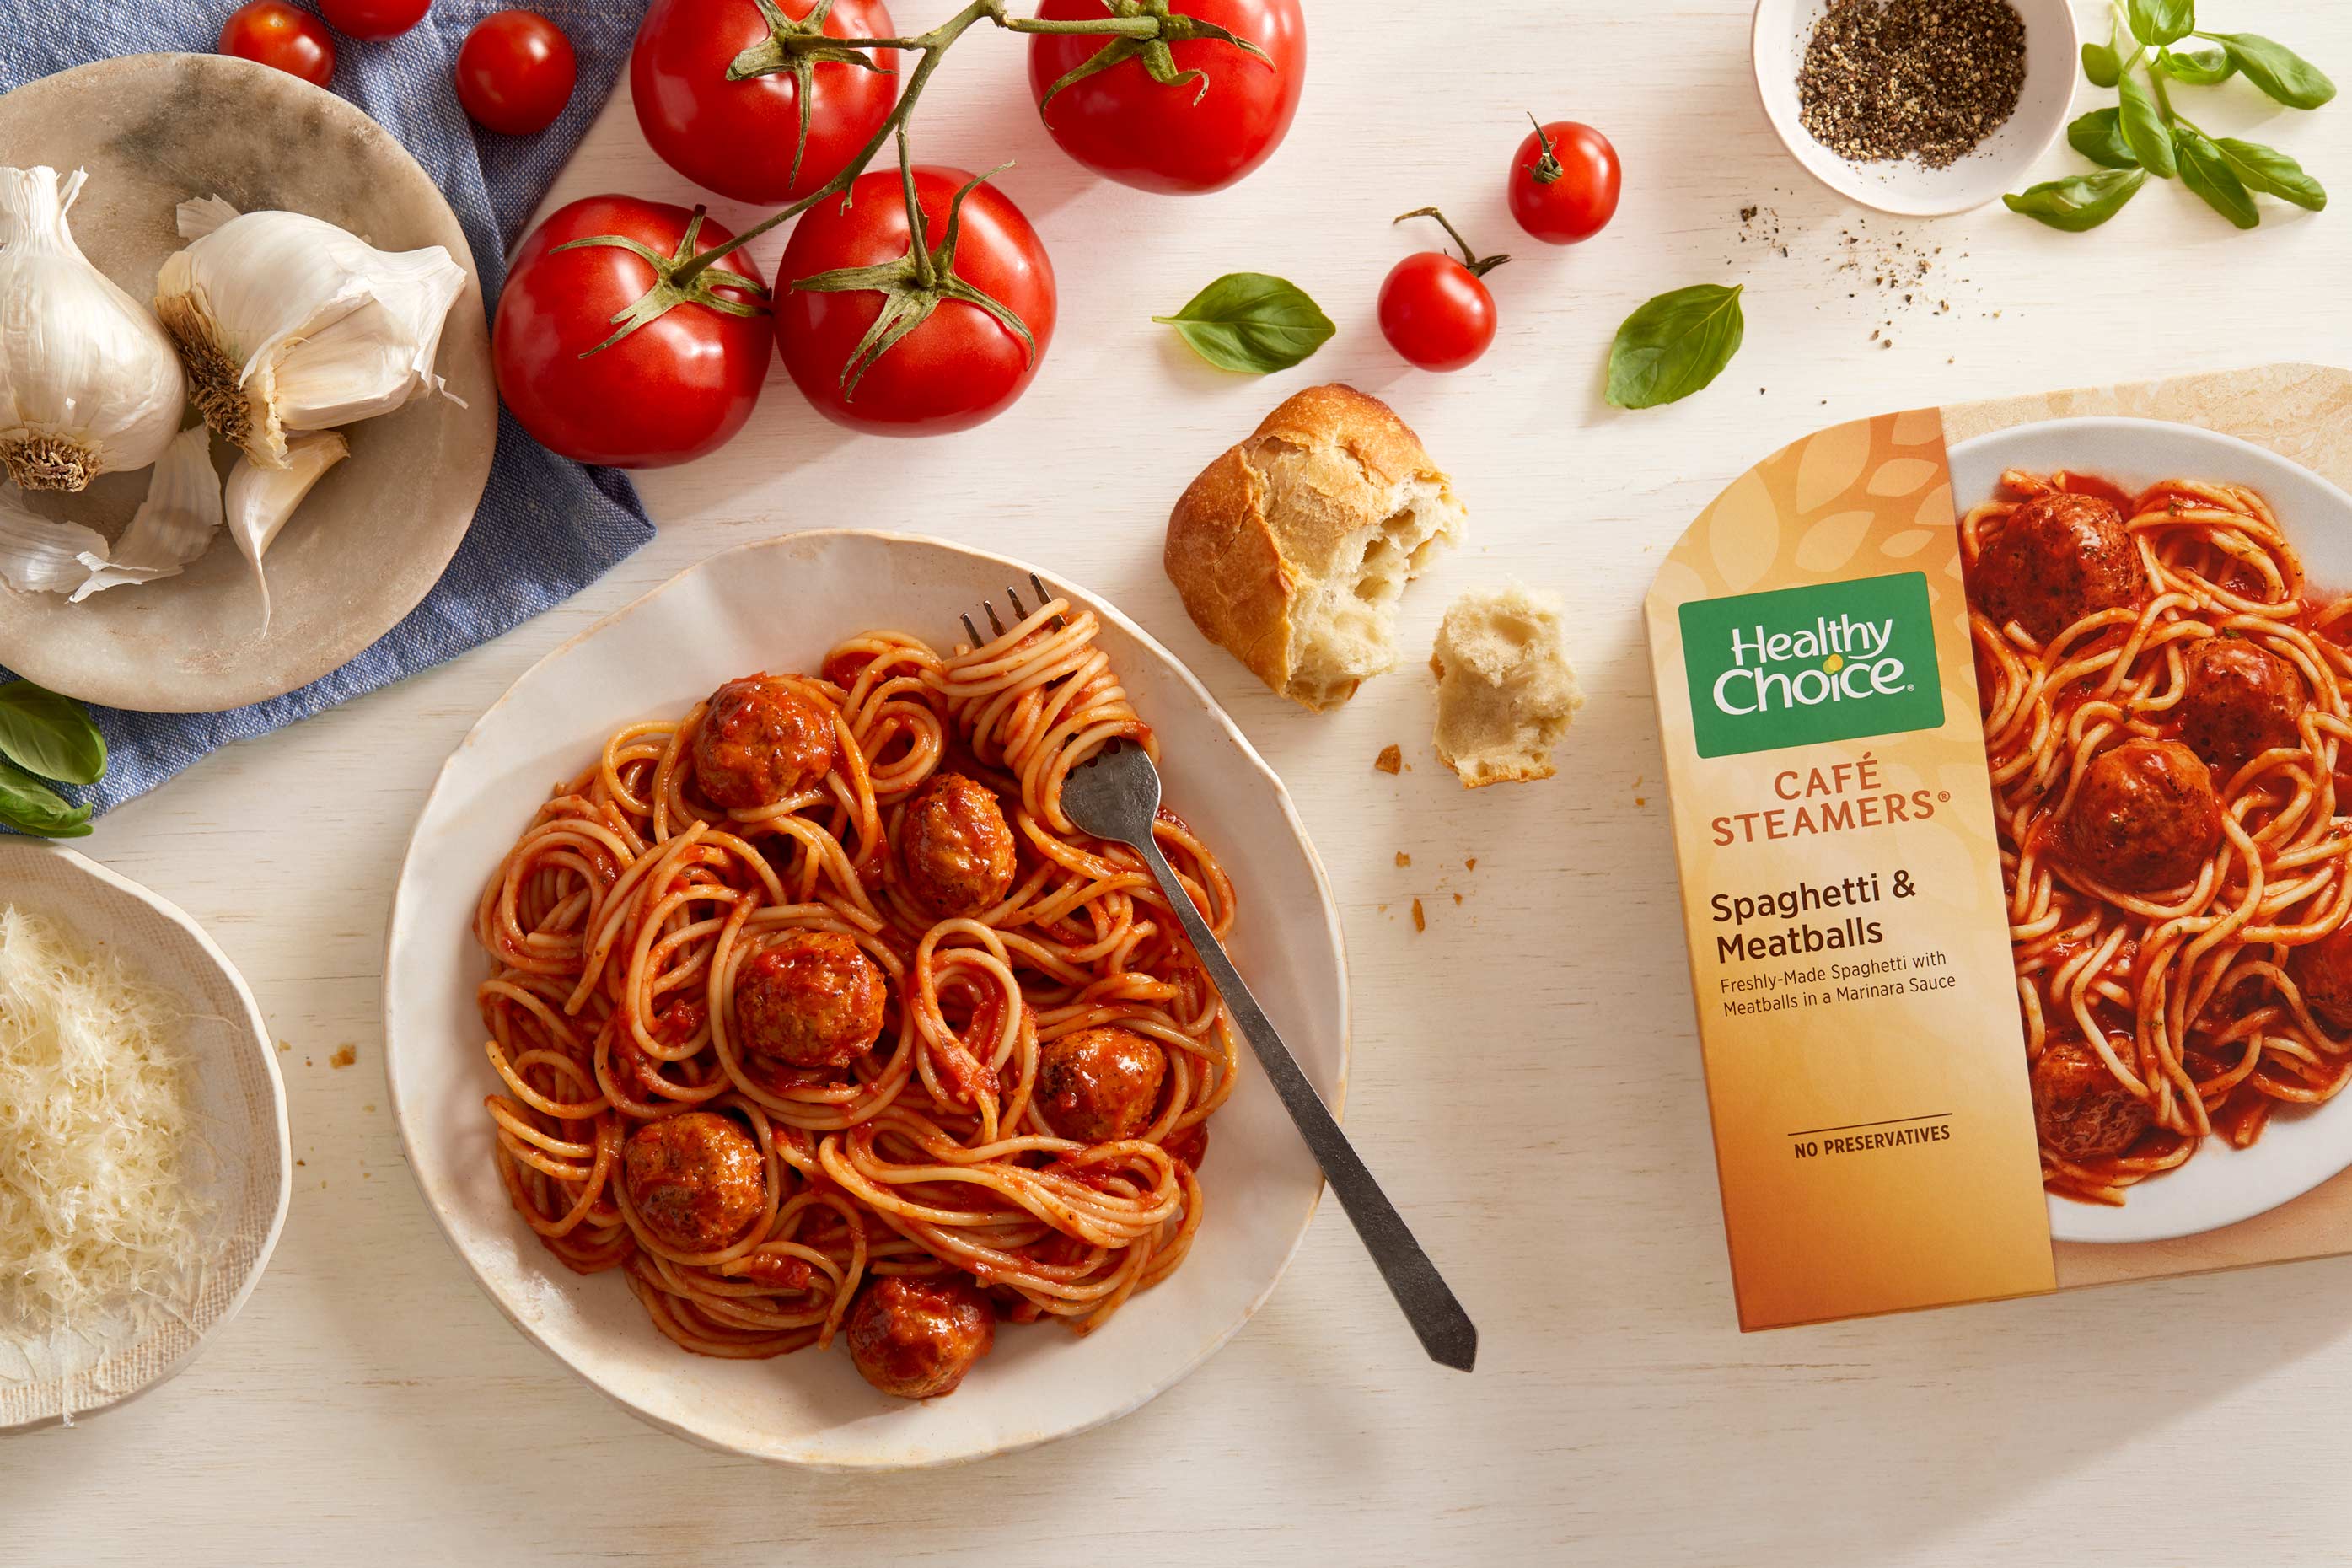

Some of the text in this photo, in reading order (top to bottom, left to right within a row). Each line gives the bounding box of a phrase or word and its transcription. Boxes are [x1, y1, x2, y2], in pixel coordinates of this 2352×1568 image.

[1731, 614, 1893, 666] Healthy
[1774, 751, 1882, 800] CAFÉ
[1711, 869, 1916, 926] Spaghetti &
[1717, 916, 1883, 964] Meatballs
[1721, 950, 1947, 994] Freshly-Made Spaghetti with
[1724, 975, 1956, 1017] Meatballs in a Marinara Sauce
[1795, 1125, 1951, 1158] NO PRESERVATIVES
